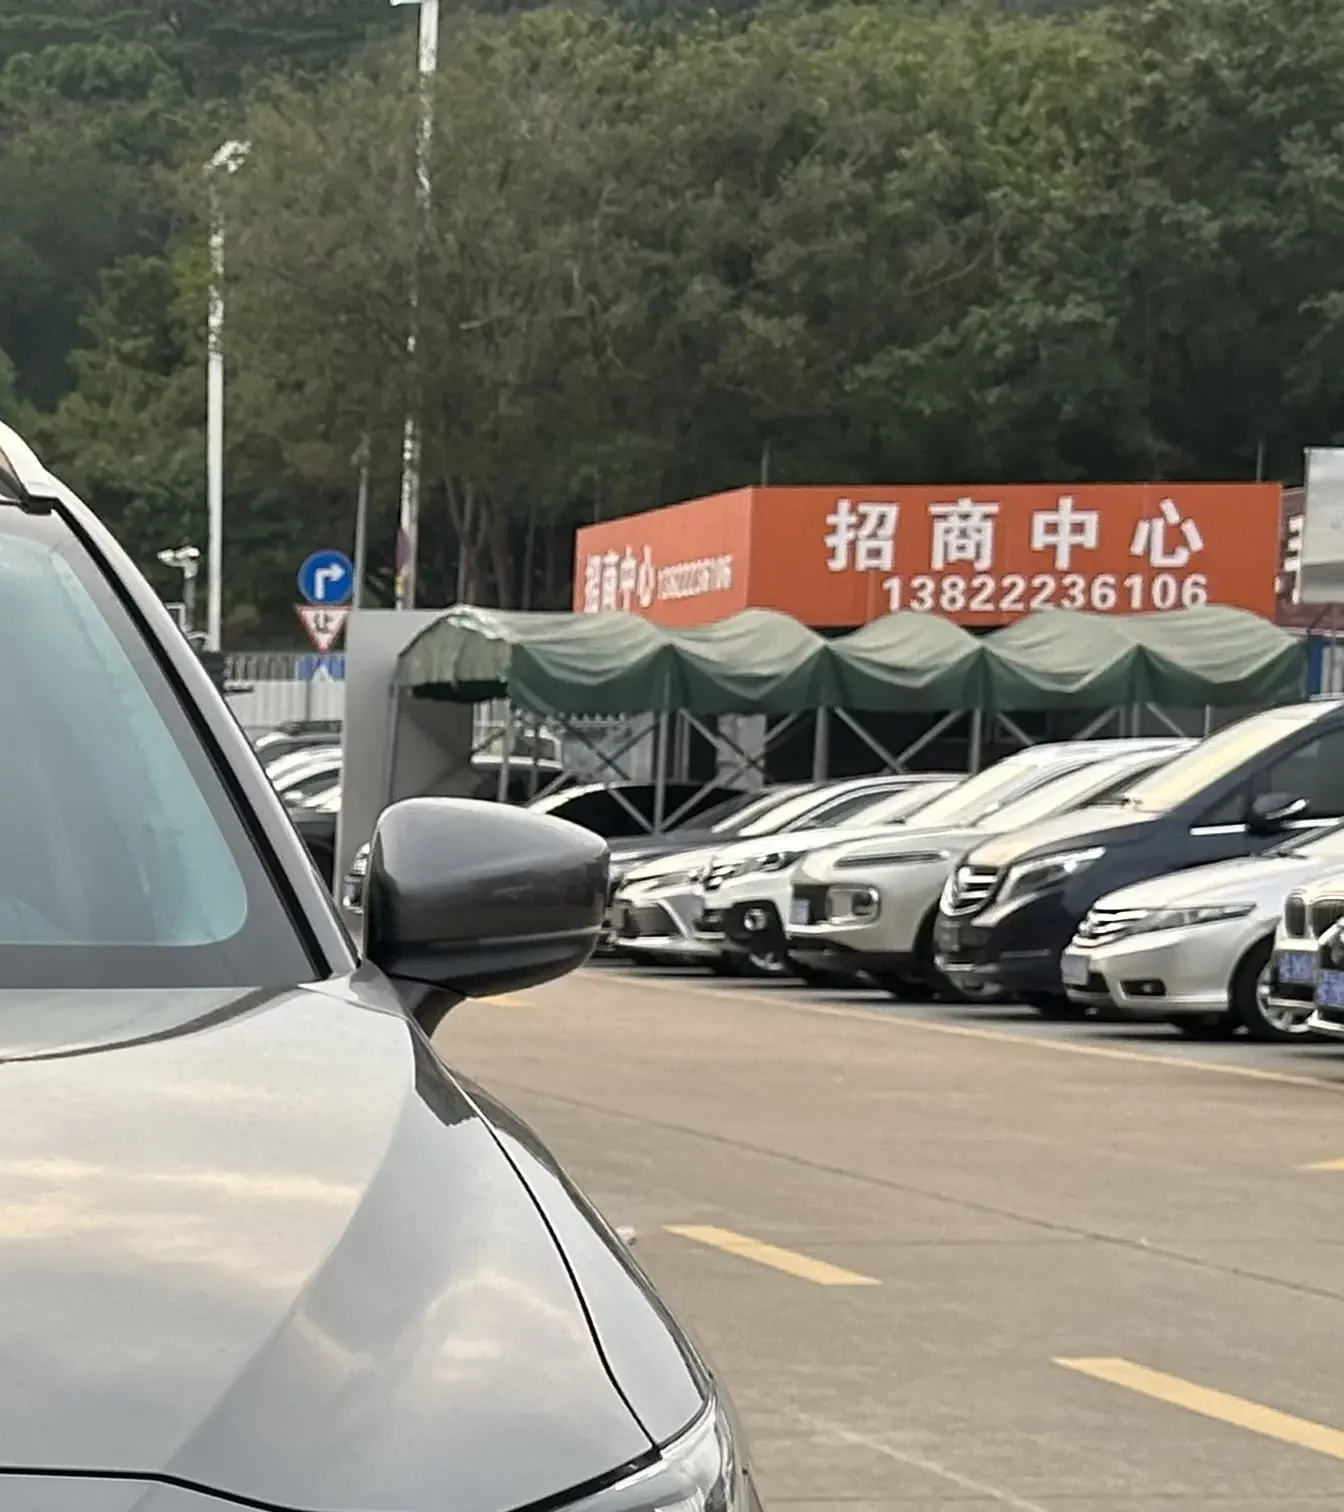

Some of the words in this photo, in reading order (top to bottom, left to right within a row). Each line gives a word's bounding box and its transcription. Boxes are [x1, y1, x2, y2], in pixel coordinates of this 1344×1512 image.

[825, 495, 1204, 572] 招商中心
[882, 574, 1208, 612] 13822236106
